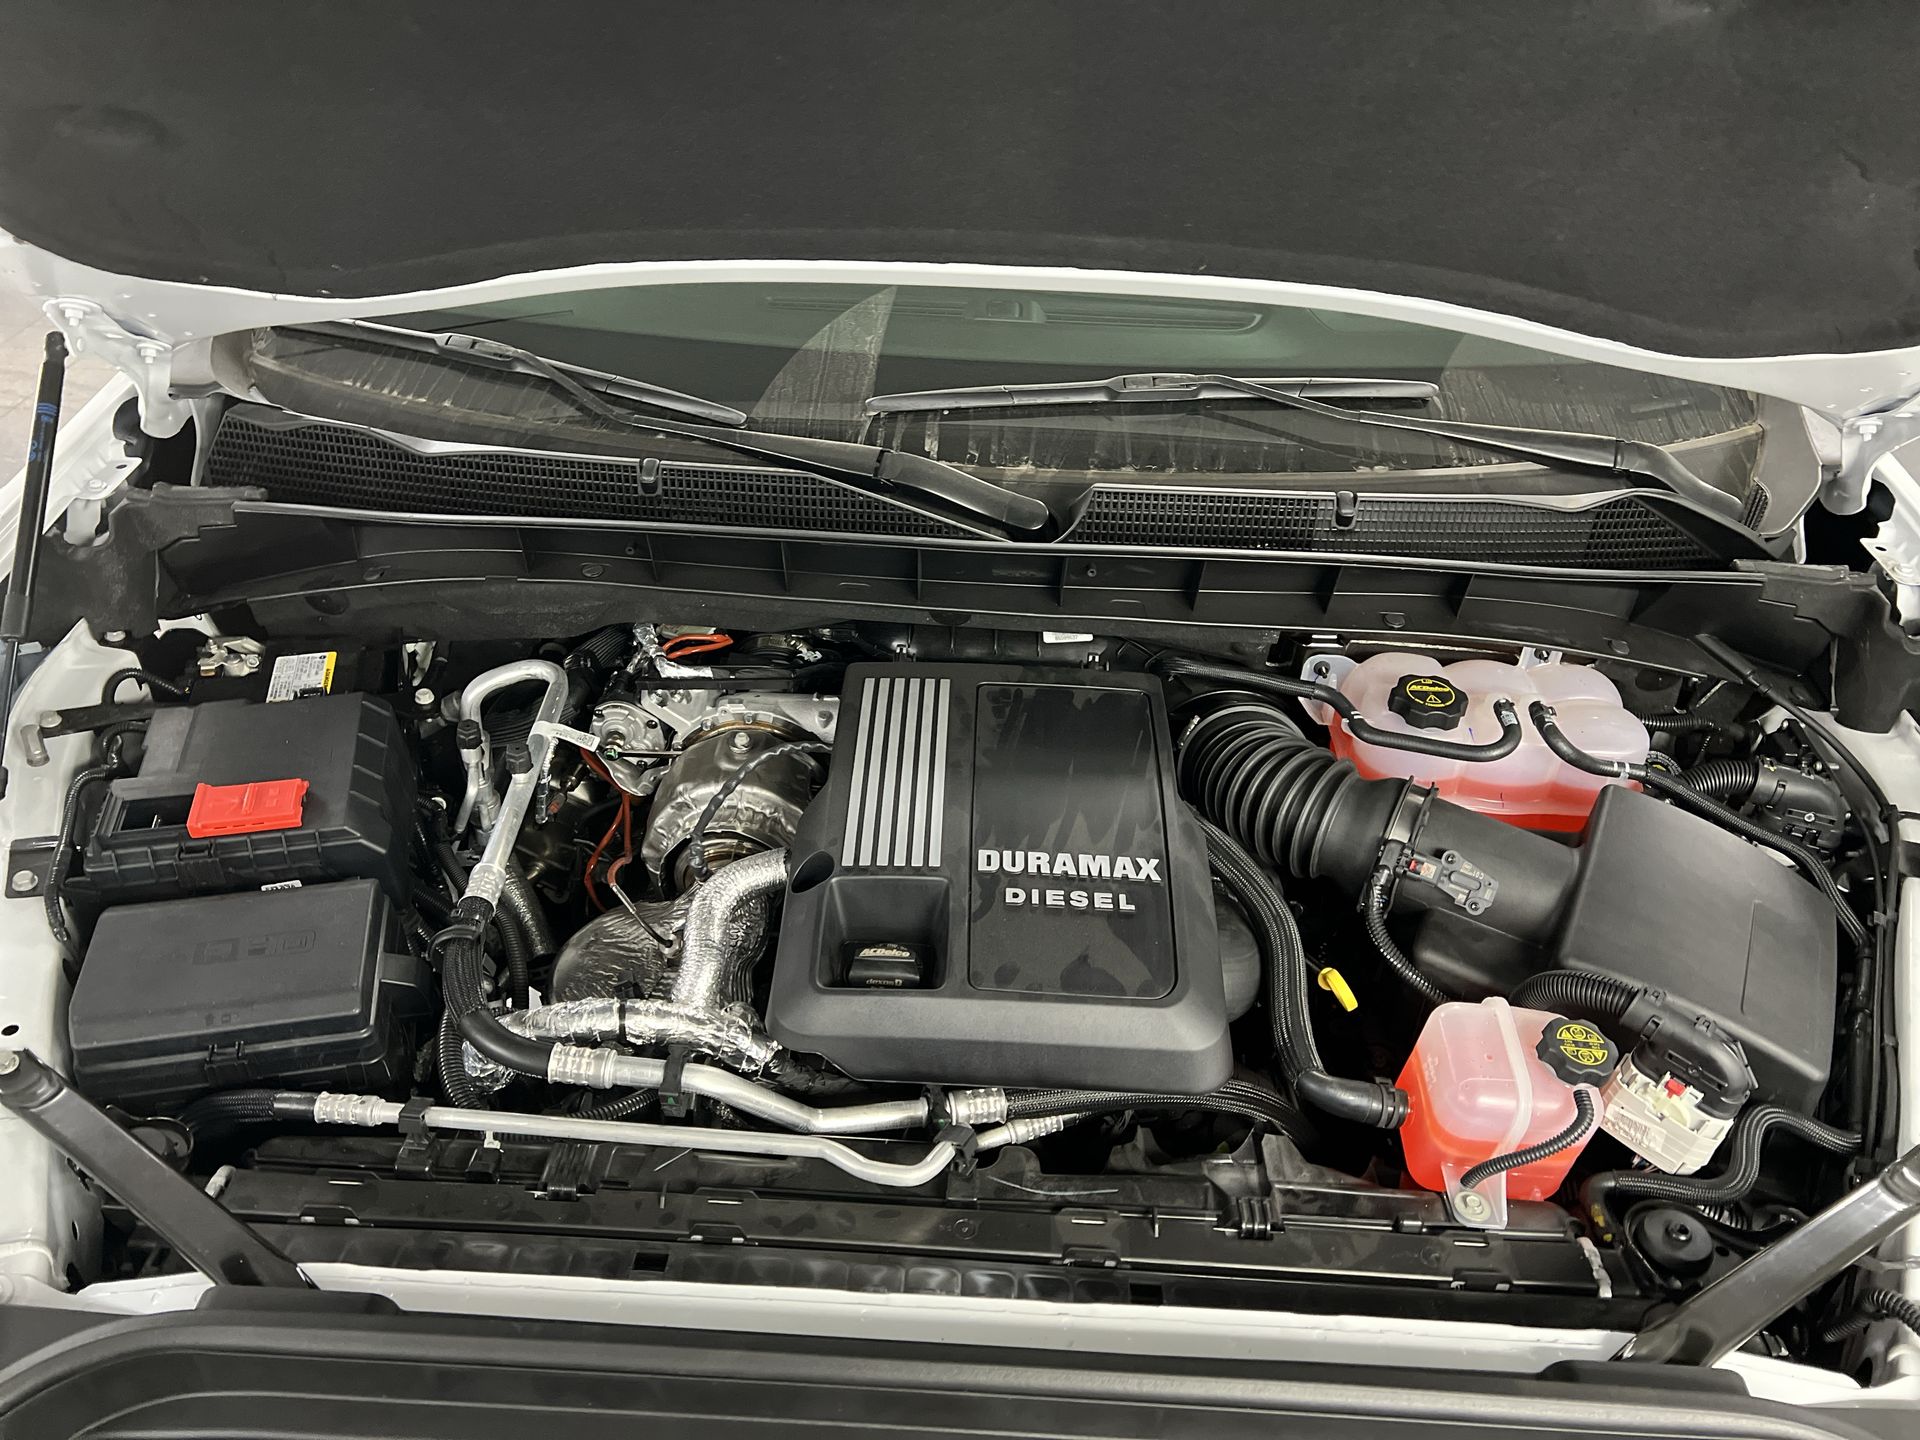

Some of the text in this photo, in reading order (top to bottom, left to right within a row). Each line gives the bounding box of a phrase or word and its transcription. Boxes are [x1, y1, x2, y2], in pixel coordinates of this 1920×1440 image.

[977, 849, 1162, 883] DURAMAX
[1005, 888, 1136, 911] DIESEL
[859, 948, 911, 957] ACDelco
